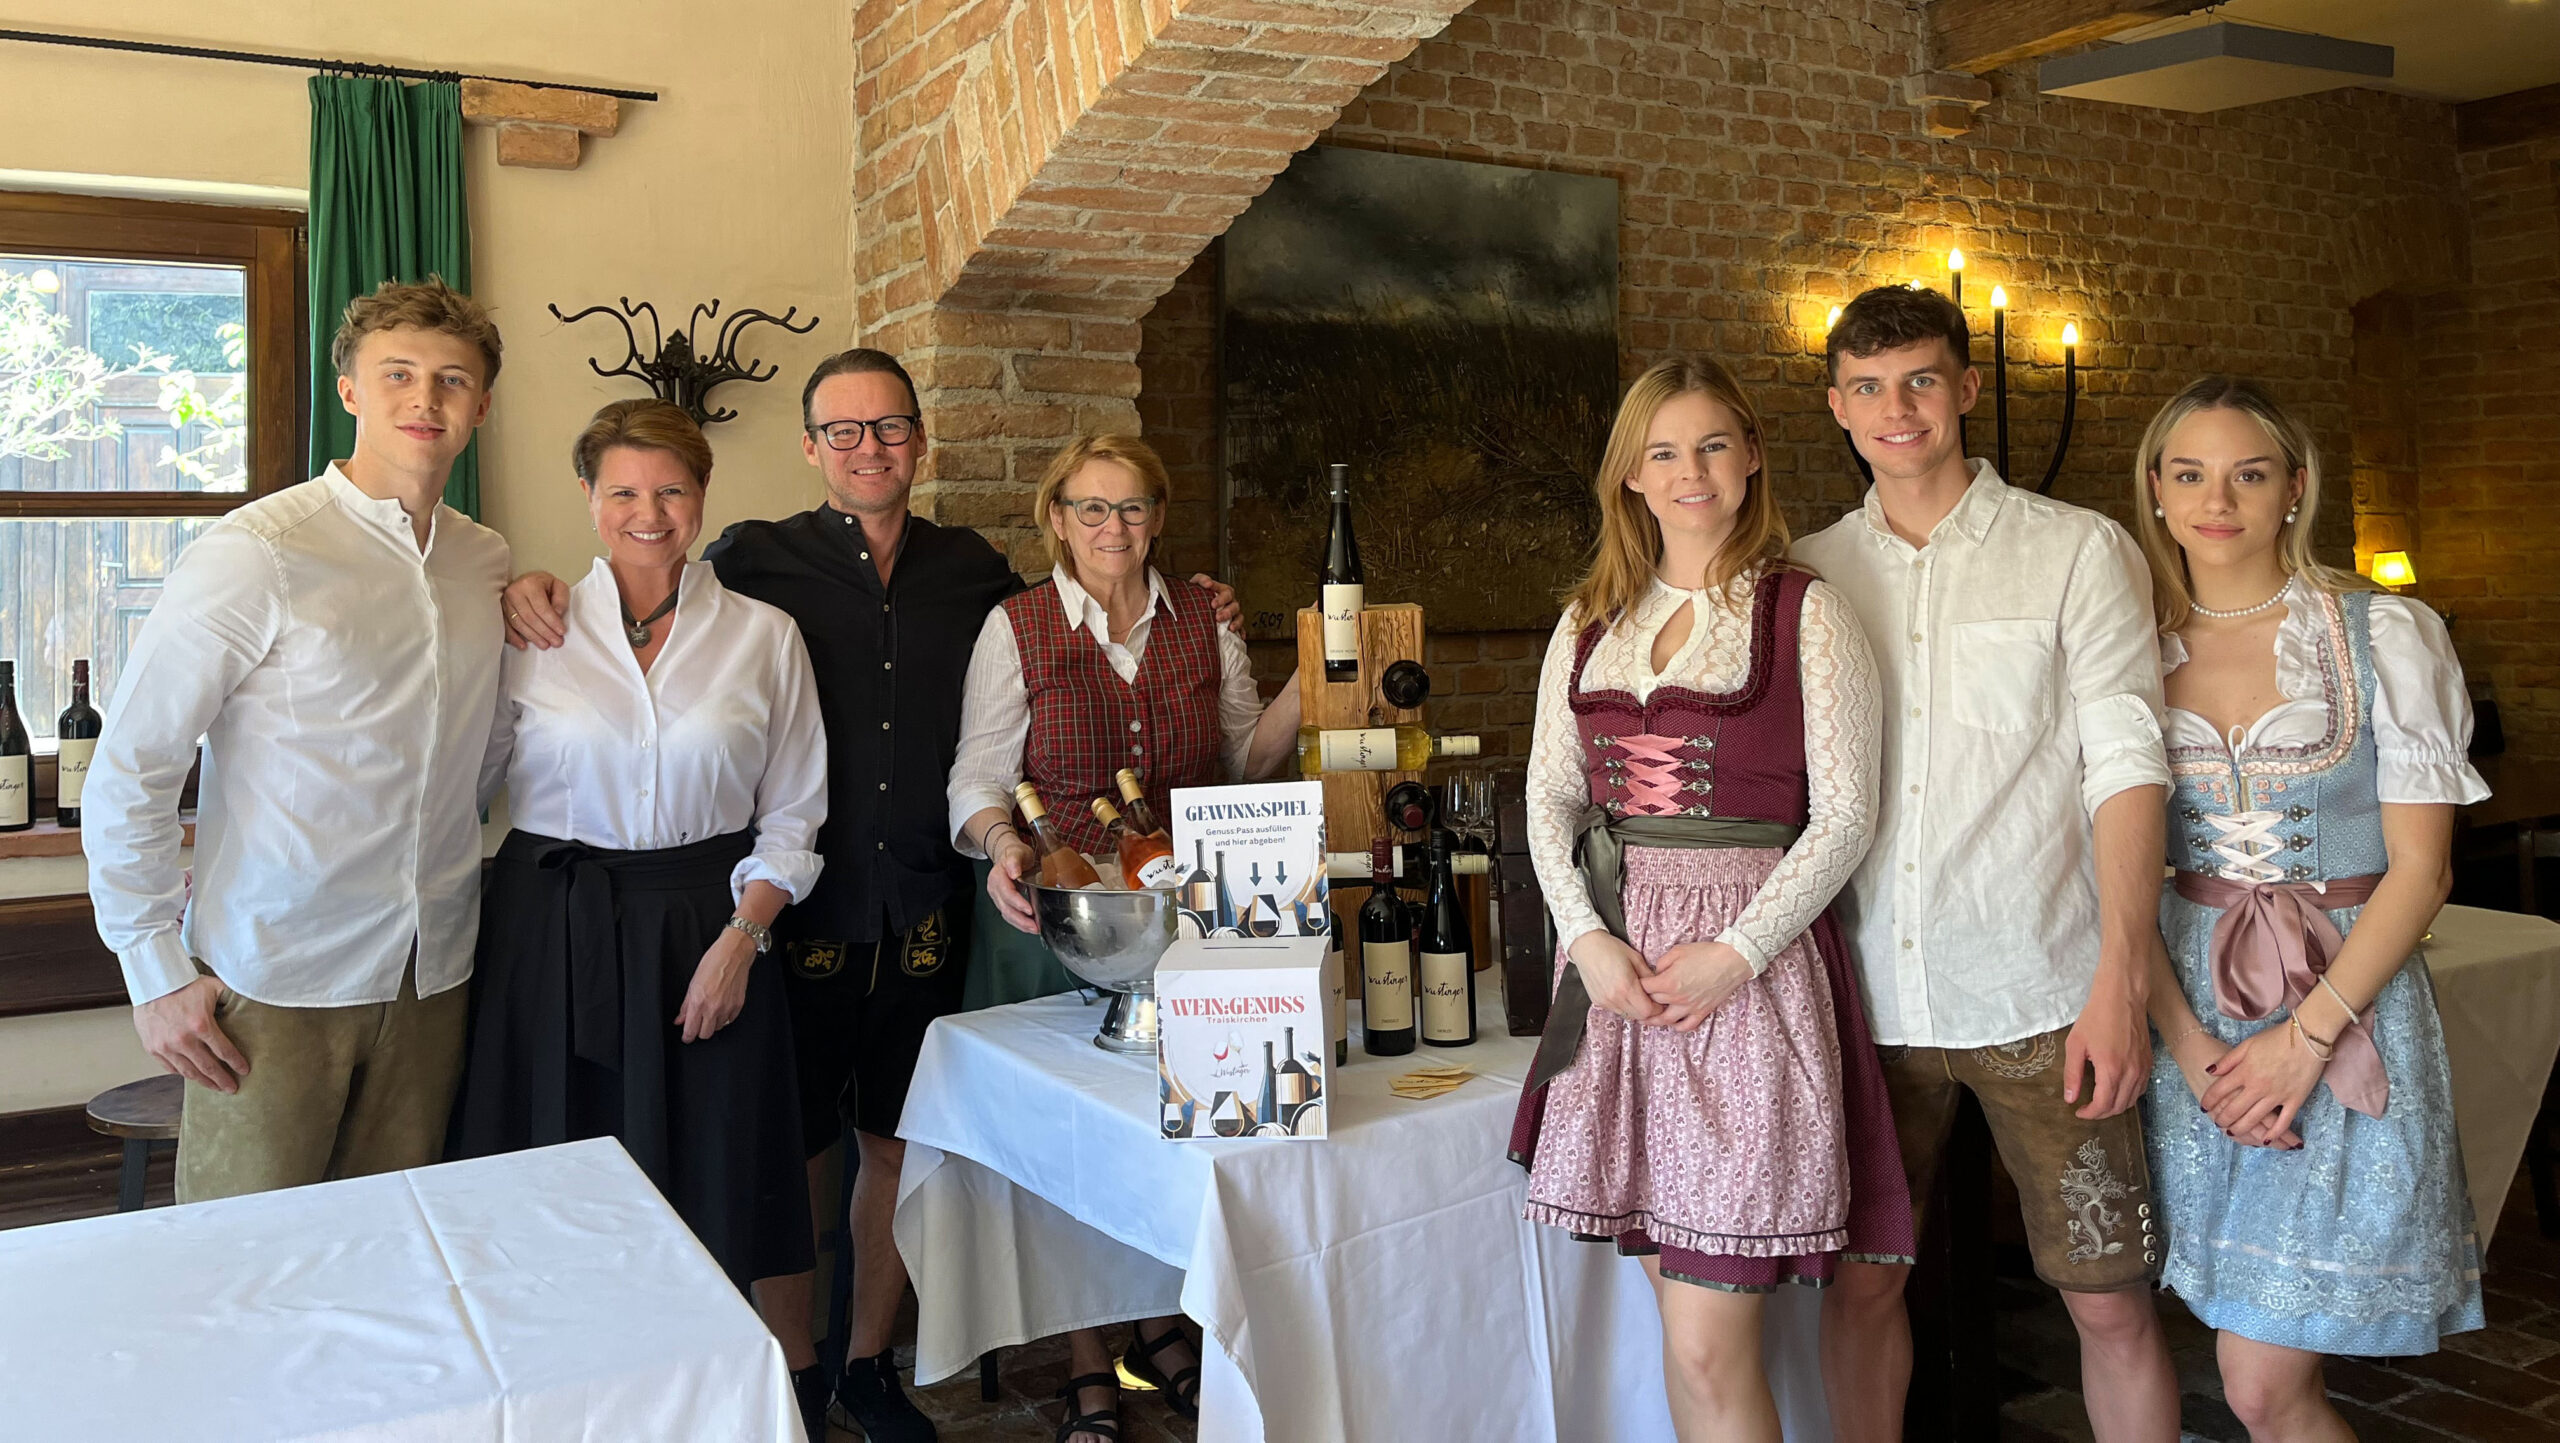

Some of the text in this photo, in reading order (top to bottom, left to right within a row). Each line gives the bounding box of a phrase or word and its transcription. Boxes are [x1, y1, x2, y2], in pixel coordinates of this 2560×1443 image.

[1185, 800, 1311, 822] GEWINN:SPIEL
[1255, 825, 1292, 833] ausfüllen
[1215, 837, 1286, 847] und hier abgeben!
[1147, 859, 1175, 879] wusti
[1171, 996, 1305, 1016] WEIN:GENUSS
[1206, 1016, 1268, 1025] Traiskirchen
